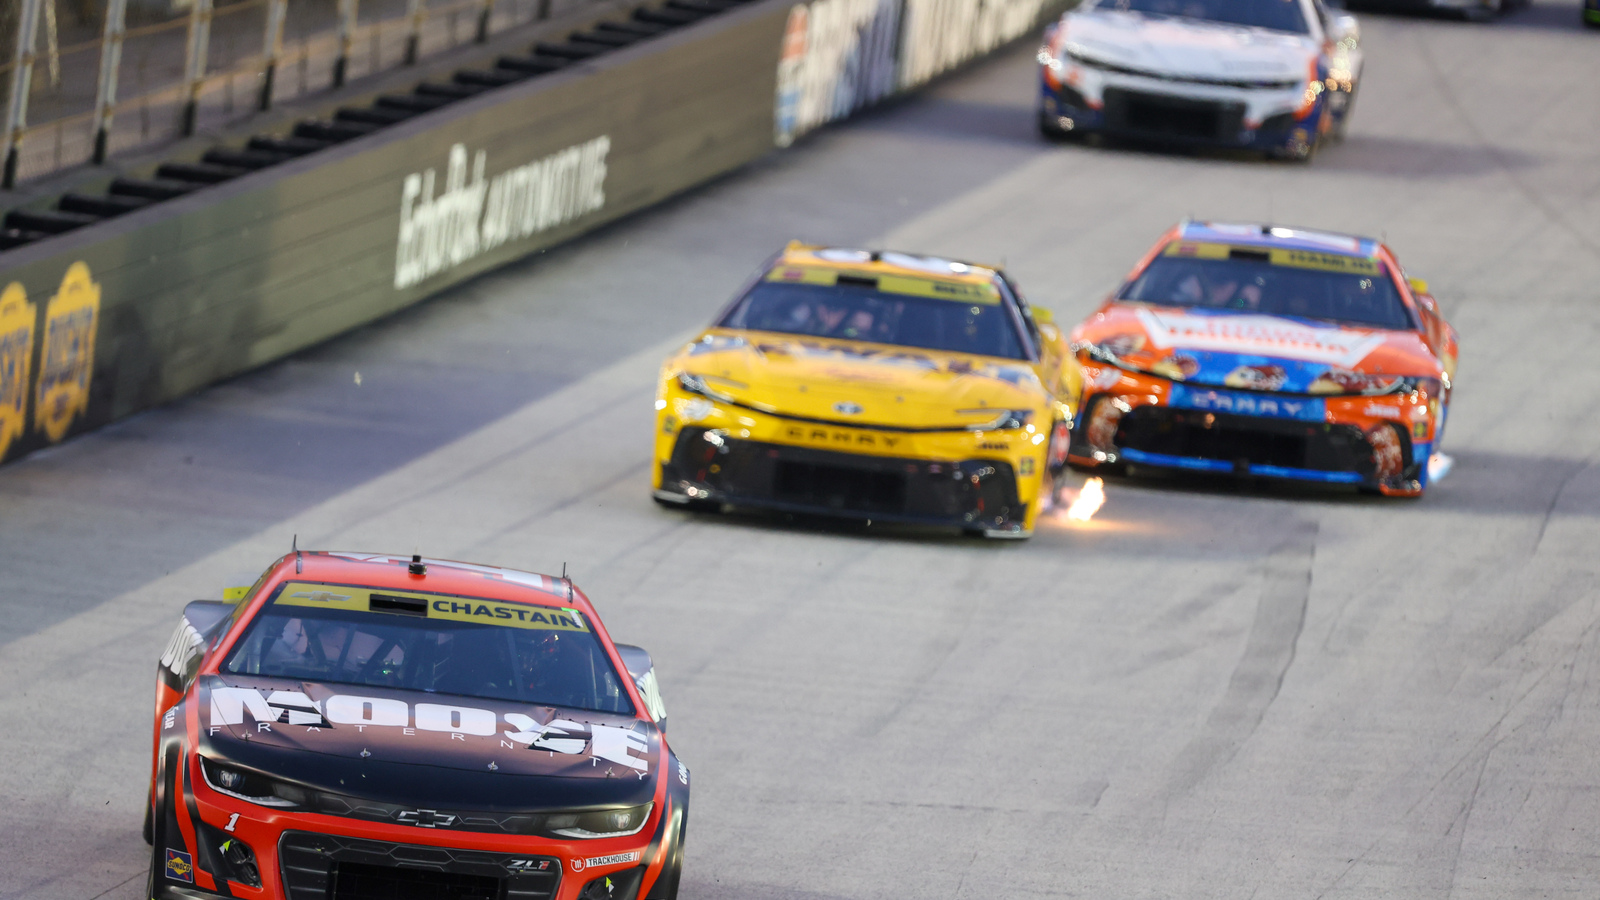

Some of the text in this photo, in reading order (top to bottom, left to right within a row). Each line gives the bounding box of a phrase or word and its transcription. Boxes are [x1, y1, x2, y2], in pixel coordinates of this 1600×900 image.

[432, 600, 582, 629] CHASTAIN
[210, 686, 649, 772] MOOSE
[224, 812, 240, 832] 1
[168, 859, 192, 873] SUNOCO
[588, 853, 632, 867] TRACKHOUSE
